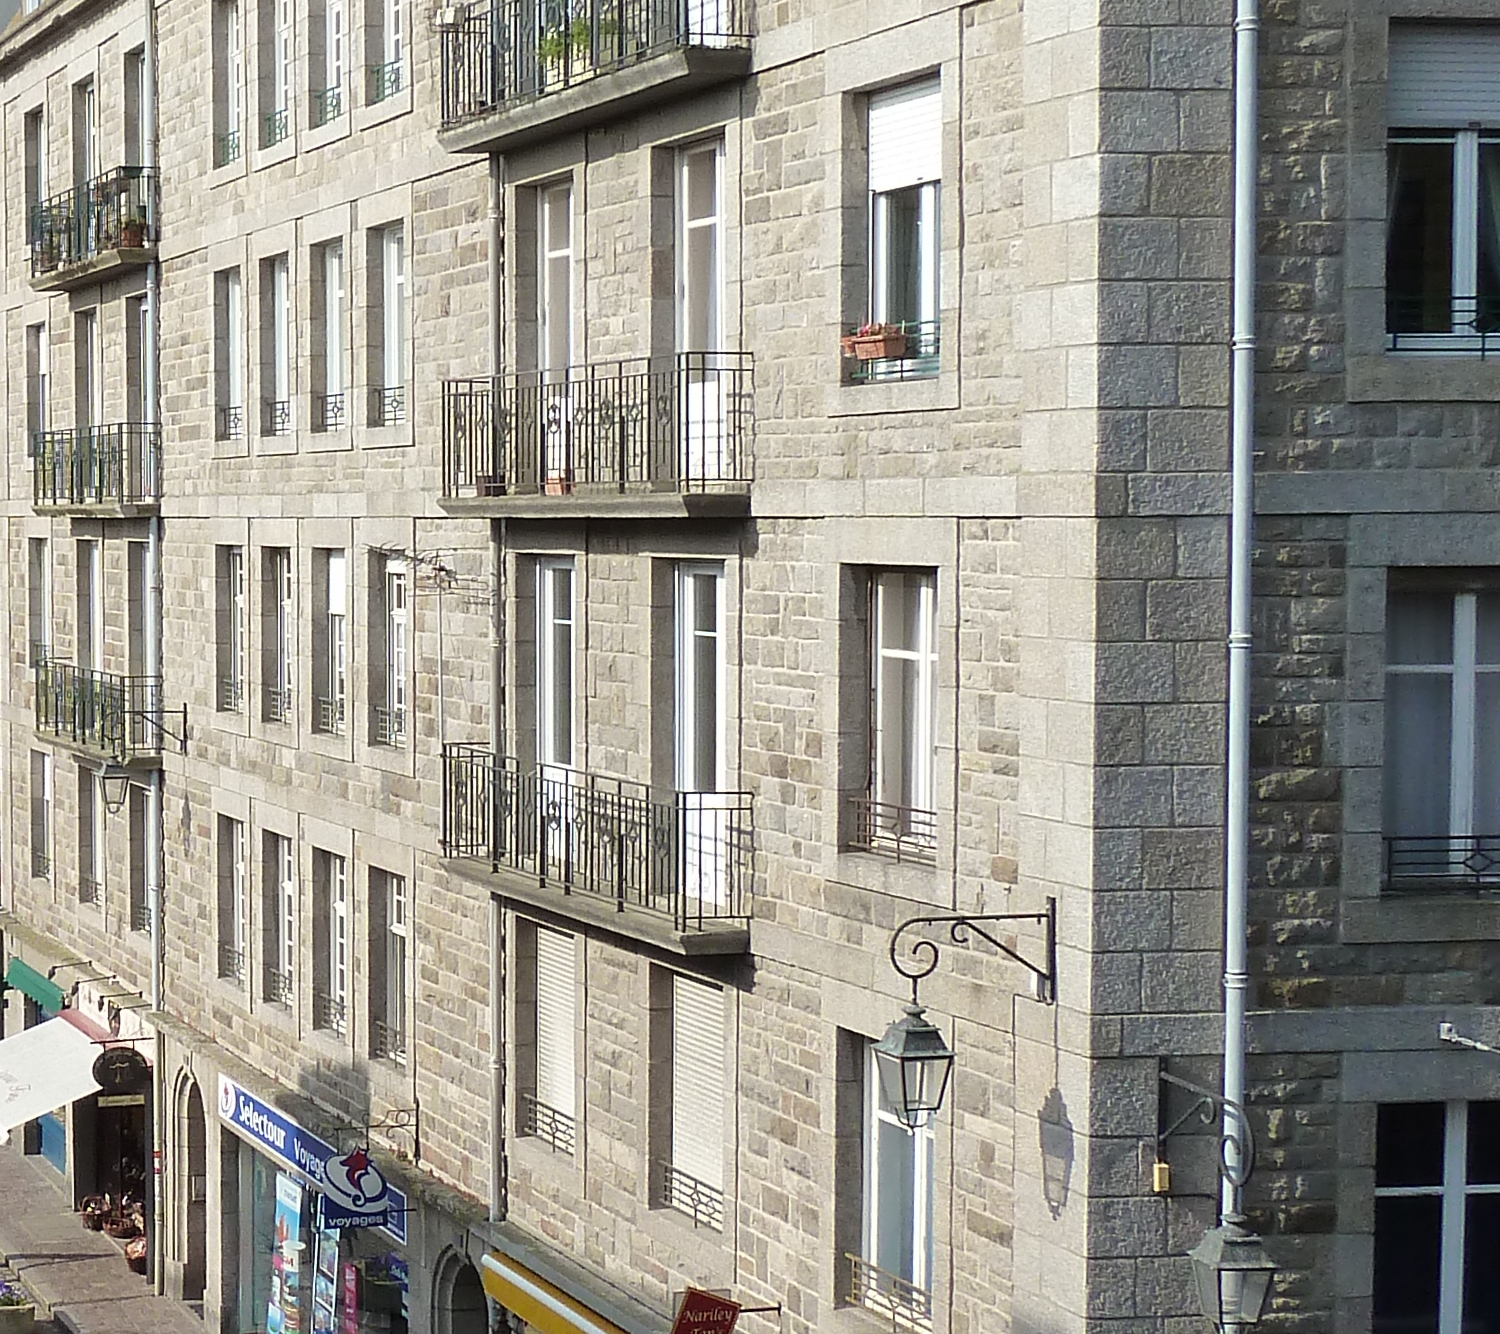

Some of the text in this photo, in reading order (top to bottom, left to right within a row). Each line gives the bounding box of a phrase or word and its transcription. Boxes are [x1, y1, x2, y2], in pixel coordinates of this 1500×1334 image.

[239, 1095, 326, 1180] Selectour Voyage
[328, 1215, 384, 1228] voyages
[681, 1306, 733, 1325] Nariley
